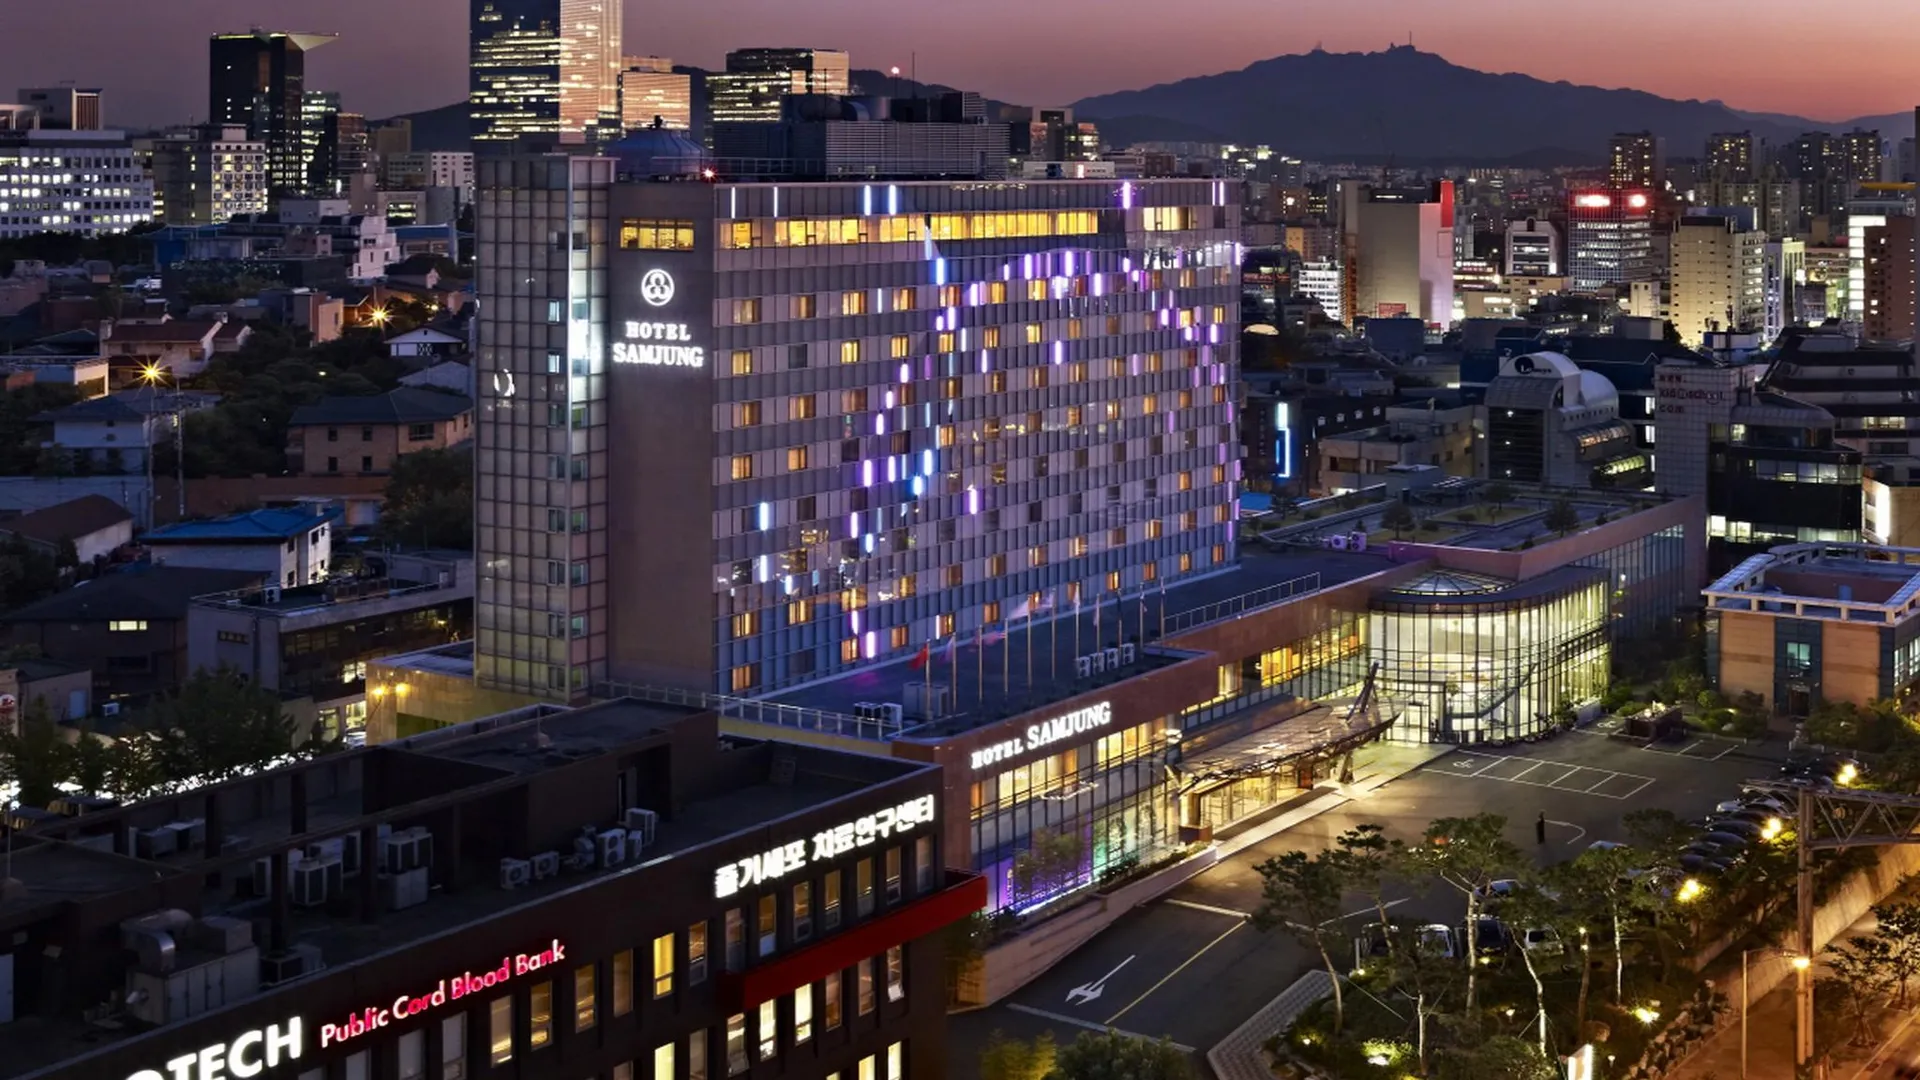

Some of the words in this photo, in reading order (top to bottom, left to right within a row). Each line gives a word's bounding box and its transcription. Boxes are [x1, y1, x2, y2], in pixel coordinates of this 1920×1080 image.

[612, 342, 704, 367] SAMJUNG
[625, 321, 691, 341] HOTEL
[971, 738, 1024, 770] HOTEL
[1027, 701, 1111, 750] SAMJUNG
[715, 839, 807, 898] 줄기세포
[812, 794, 935, 861] 치료연구센터
[320, 1006, 389, 1048] Public
[393, 980, 445, 1019] Cord
[451, 957, 510, 1000] Blood
[515, 939, 566, 976] Bank
[125, 1016, 303, 1080] TECH
